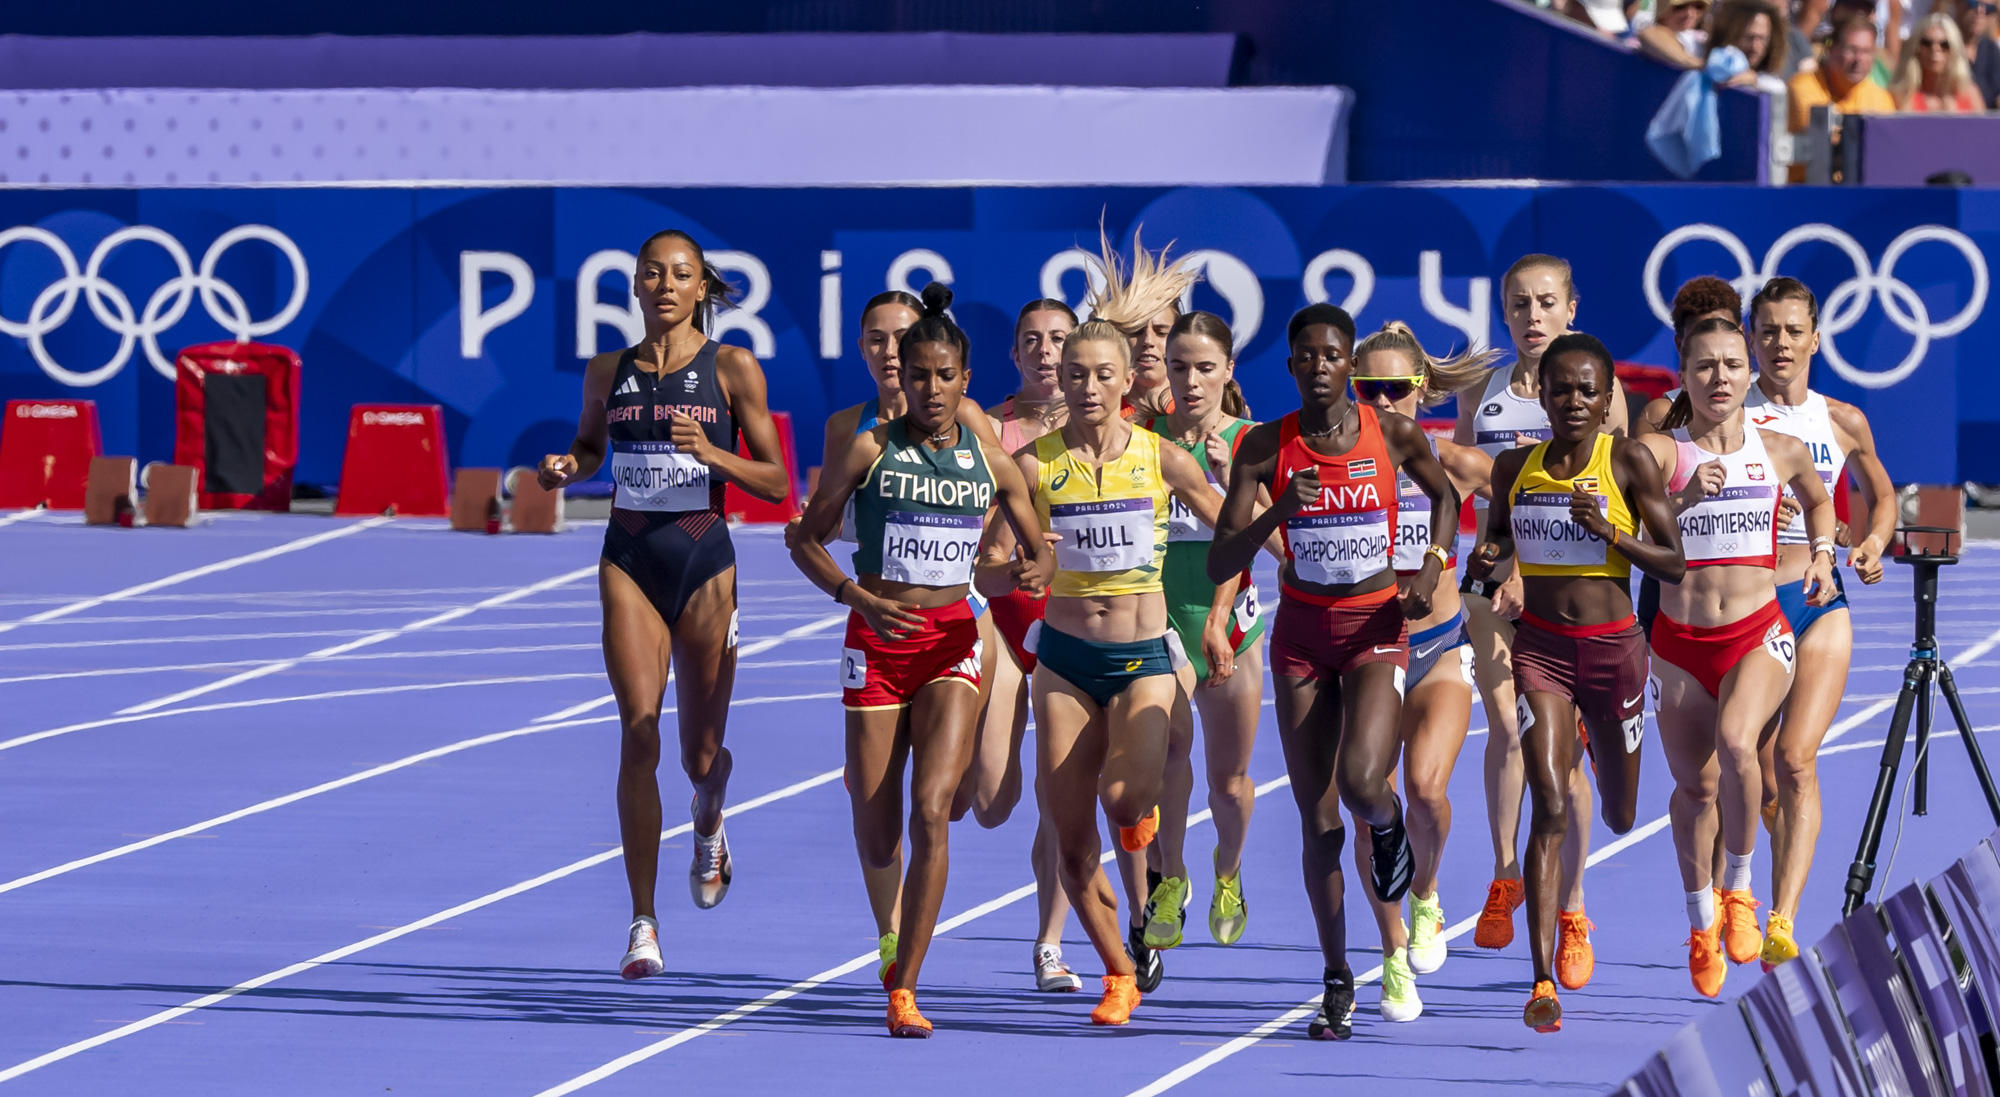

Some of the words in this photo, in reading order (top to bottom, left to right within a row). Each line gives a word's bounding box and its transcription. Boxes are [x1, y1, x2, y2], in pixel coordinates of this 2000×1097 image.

[614, 465, 706, 489] WALCOTT-NOLAN
[879, 470, 990, 510] ETHIOPIA
[1103, 502, 1127, 511] 2024
[941, 516, 963, 526] 2024
[1340, 516, 1365, 524] 2024
[1679, 510, 1771, 538] KAZIMIERSKA
[887, 536, 977, 562] HAYLOM
[1075, 525, 1134, 549] HULL
[1246, 595, 1255, 618] 6
[846, 655, 857, 681] 2
[1629, 714, 1644, 743] 12
